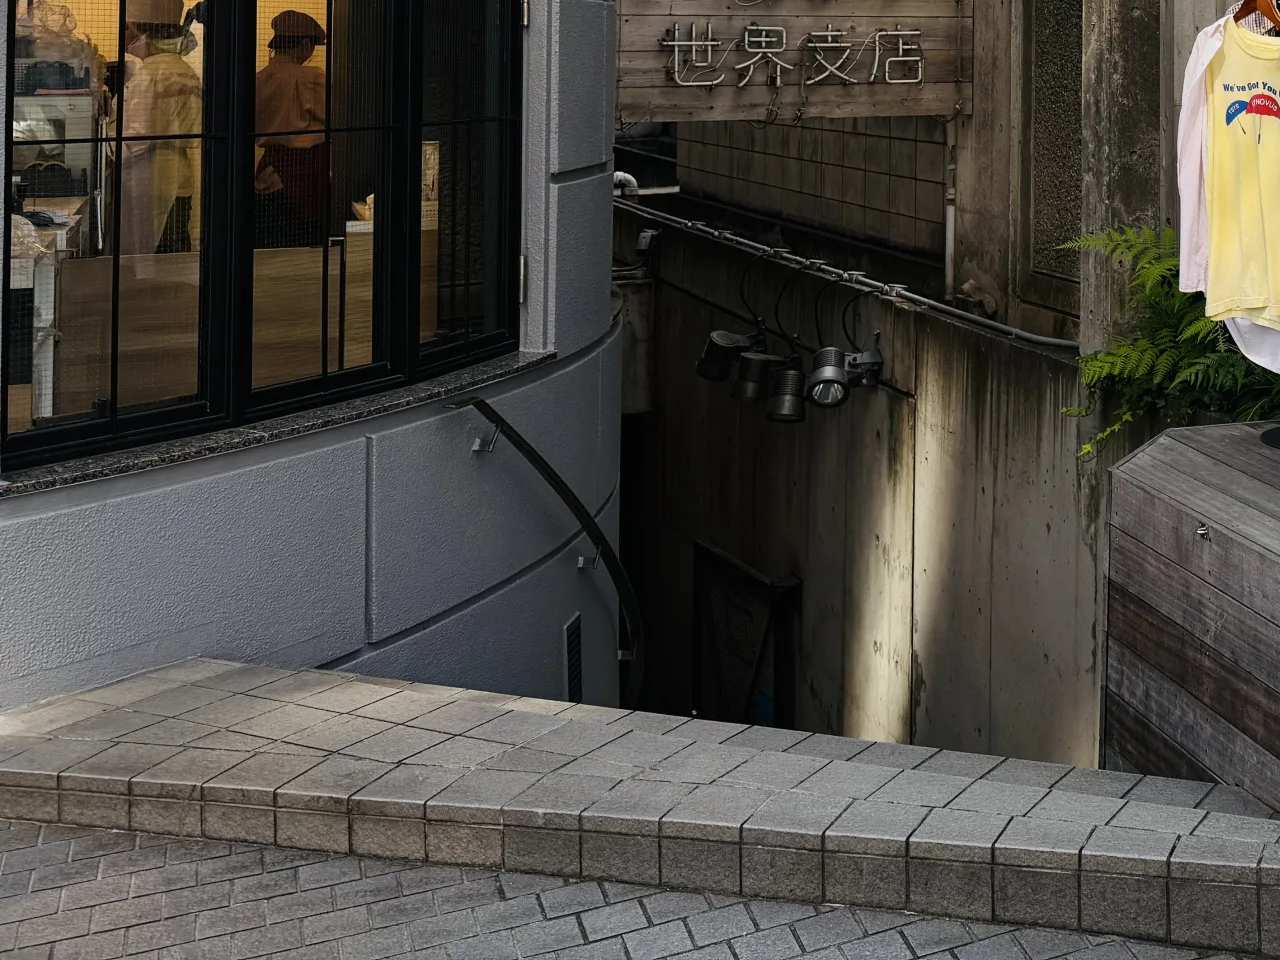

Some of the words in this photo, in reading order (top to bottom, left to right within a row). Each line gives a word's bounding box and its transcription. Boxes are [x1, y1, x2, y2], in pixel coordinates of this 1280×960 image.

[660, 21, 926, 88] 世界支店
[1222, 83, 1247, 92] We've
[1247, 81, 1259, 91] Got
[1262, 81, 1278, 97] You
